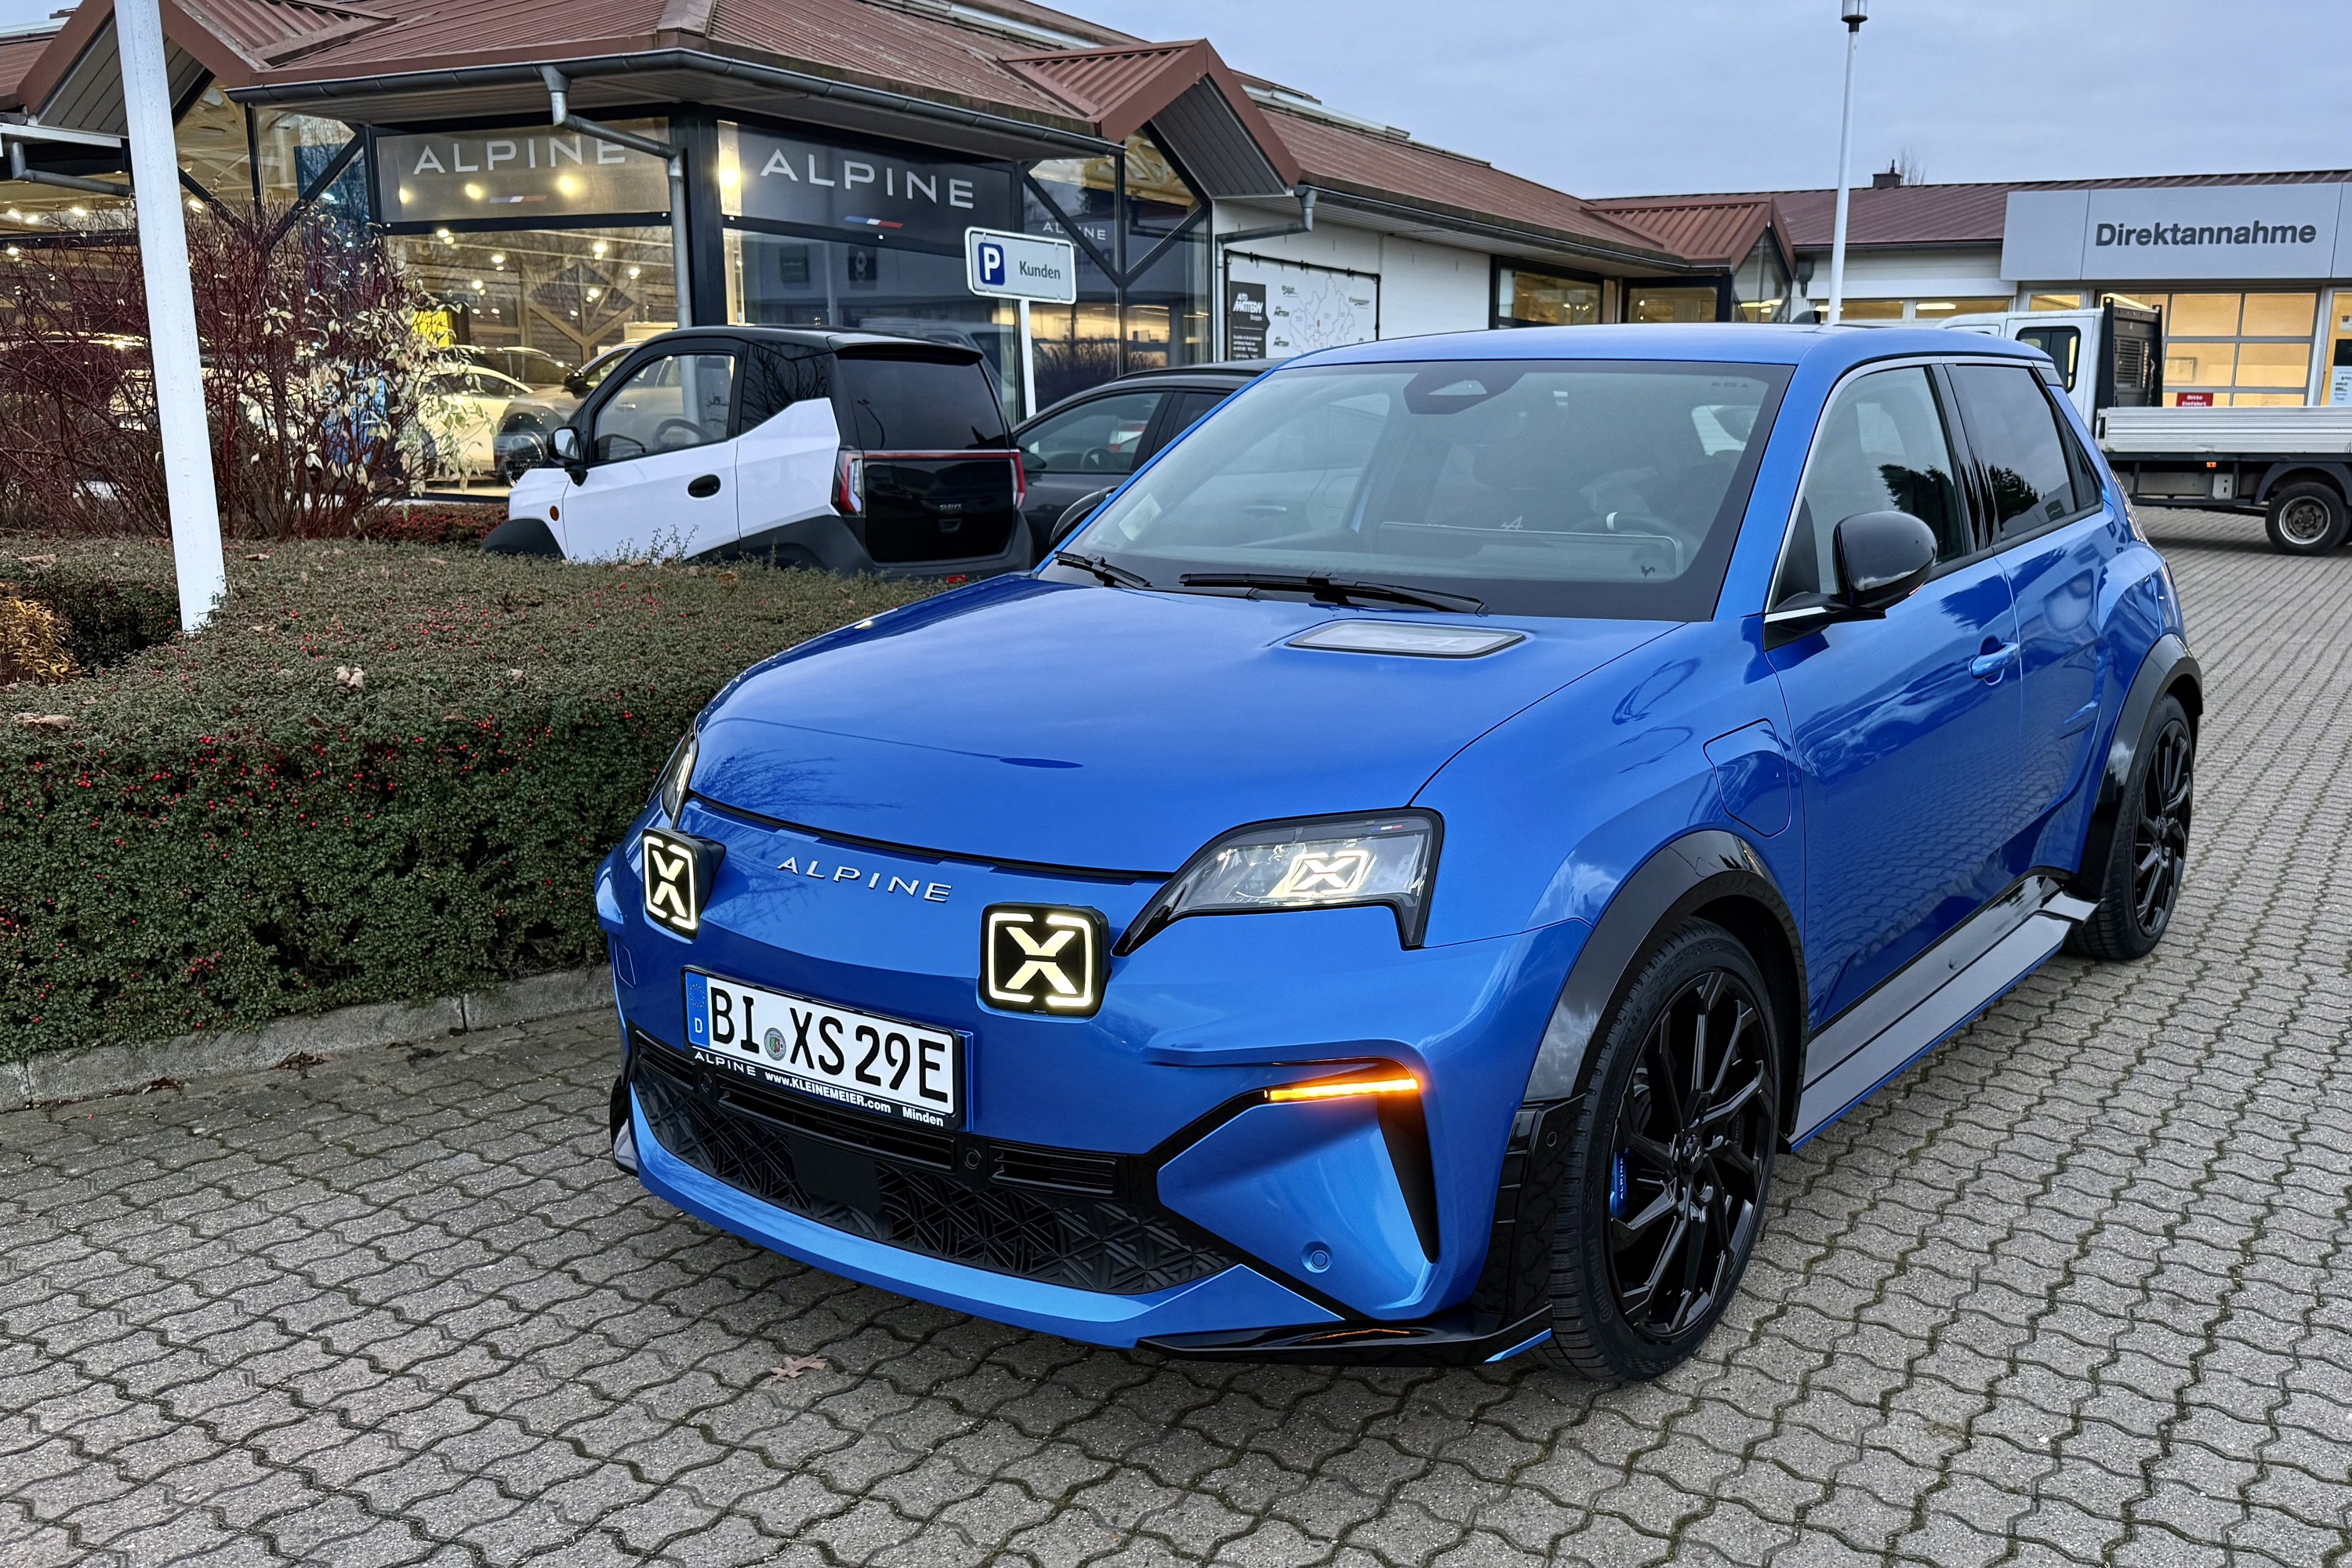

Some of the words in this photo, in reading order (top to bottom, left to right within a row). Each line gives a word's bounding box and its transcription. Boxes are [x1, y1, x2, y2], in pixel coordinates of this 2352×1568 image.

[413, 136, 626, 175] ALPINE
[760, 148, 974, 209] ALPINE
[1043, 222, 1106, 241] ALNE
[2096, 220, 2317, 246] Direktannahme
[984, 247, 1000, 281] P
[1019, 260, 1061, 279] Kunden
[777, 856, 952, 902] ALPINE
[695, 1018, 703, 1033] D
[710, 986, 760, 1054] BI
[695, 1051, 757, 1076] ALPINE
[764, 1072, 891, 1113] www.KLEINEMEIER.com
[902, 1106, 944, 1127] Minden
